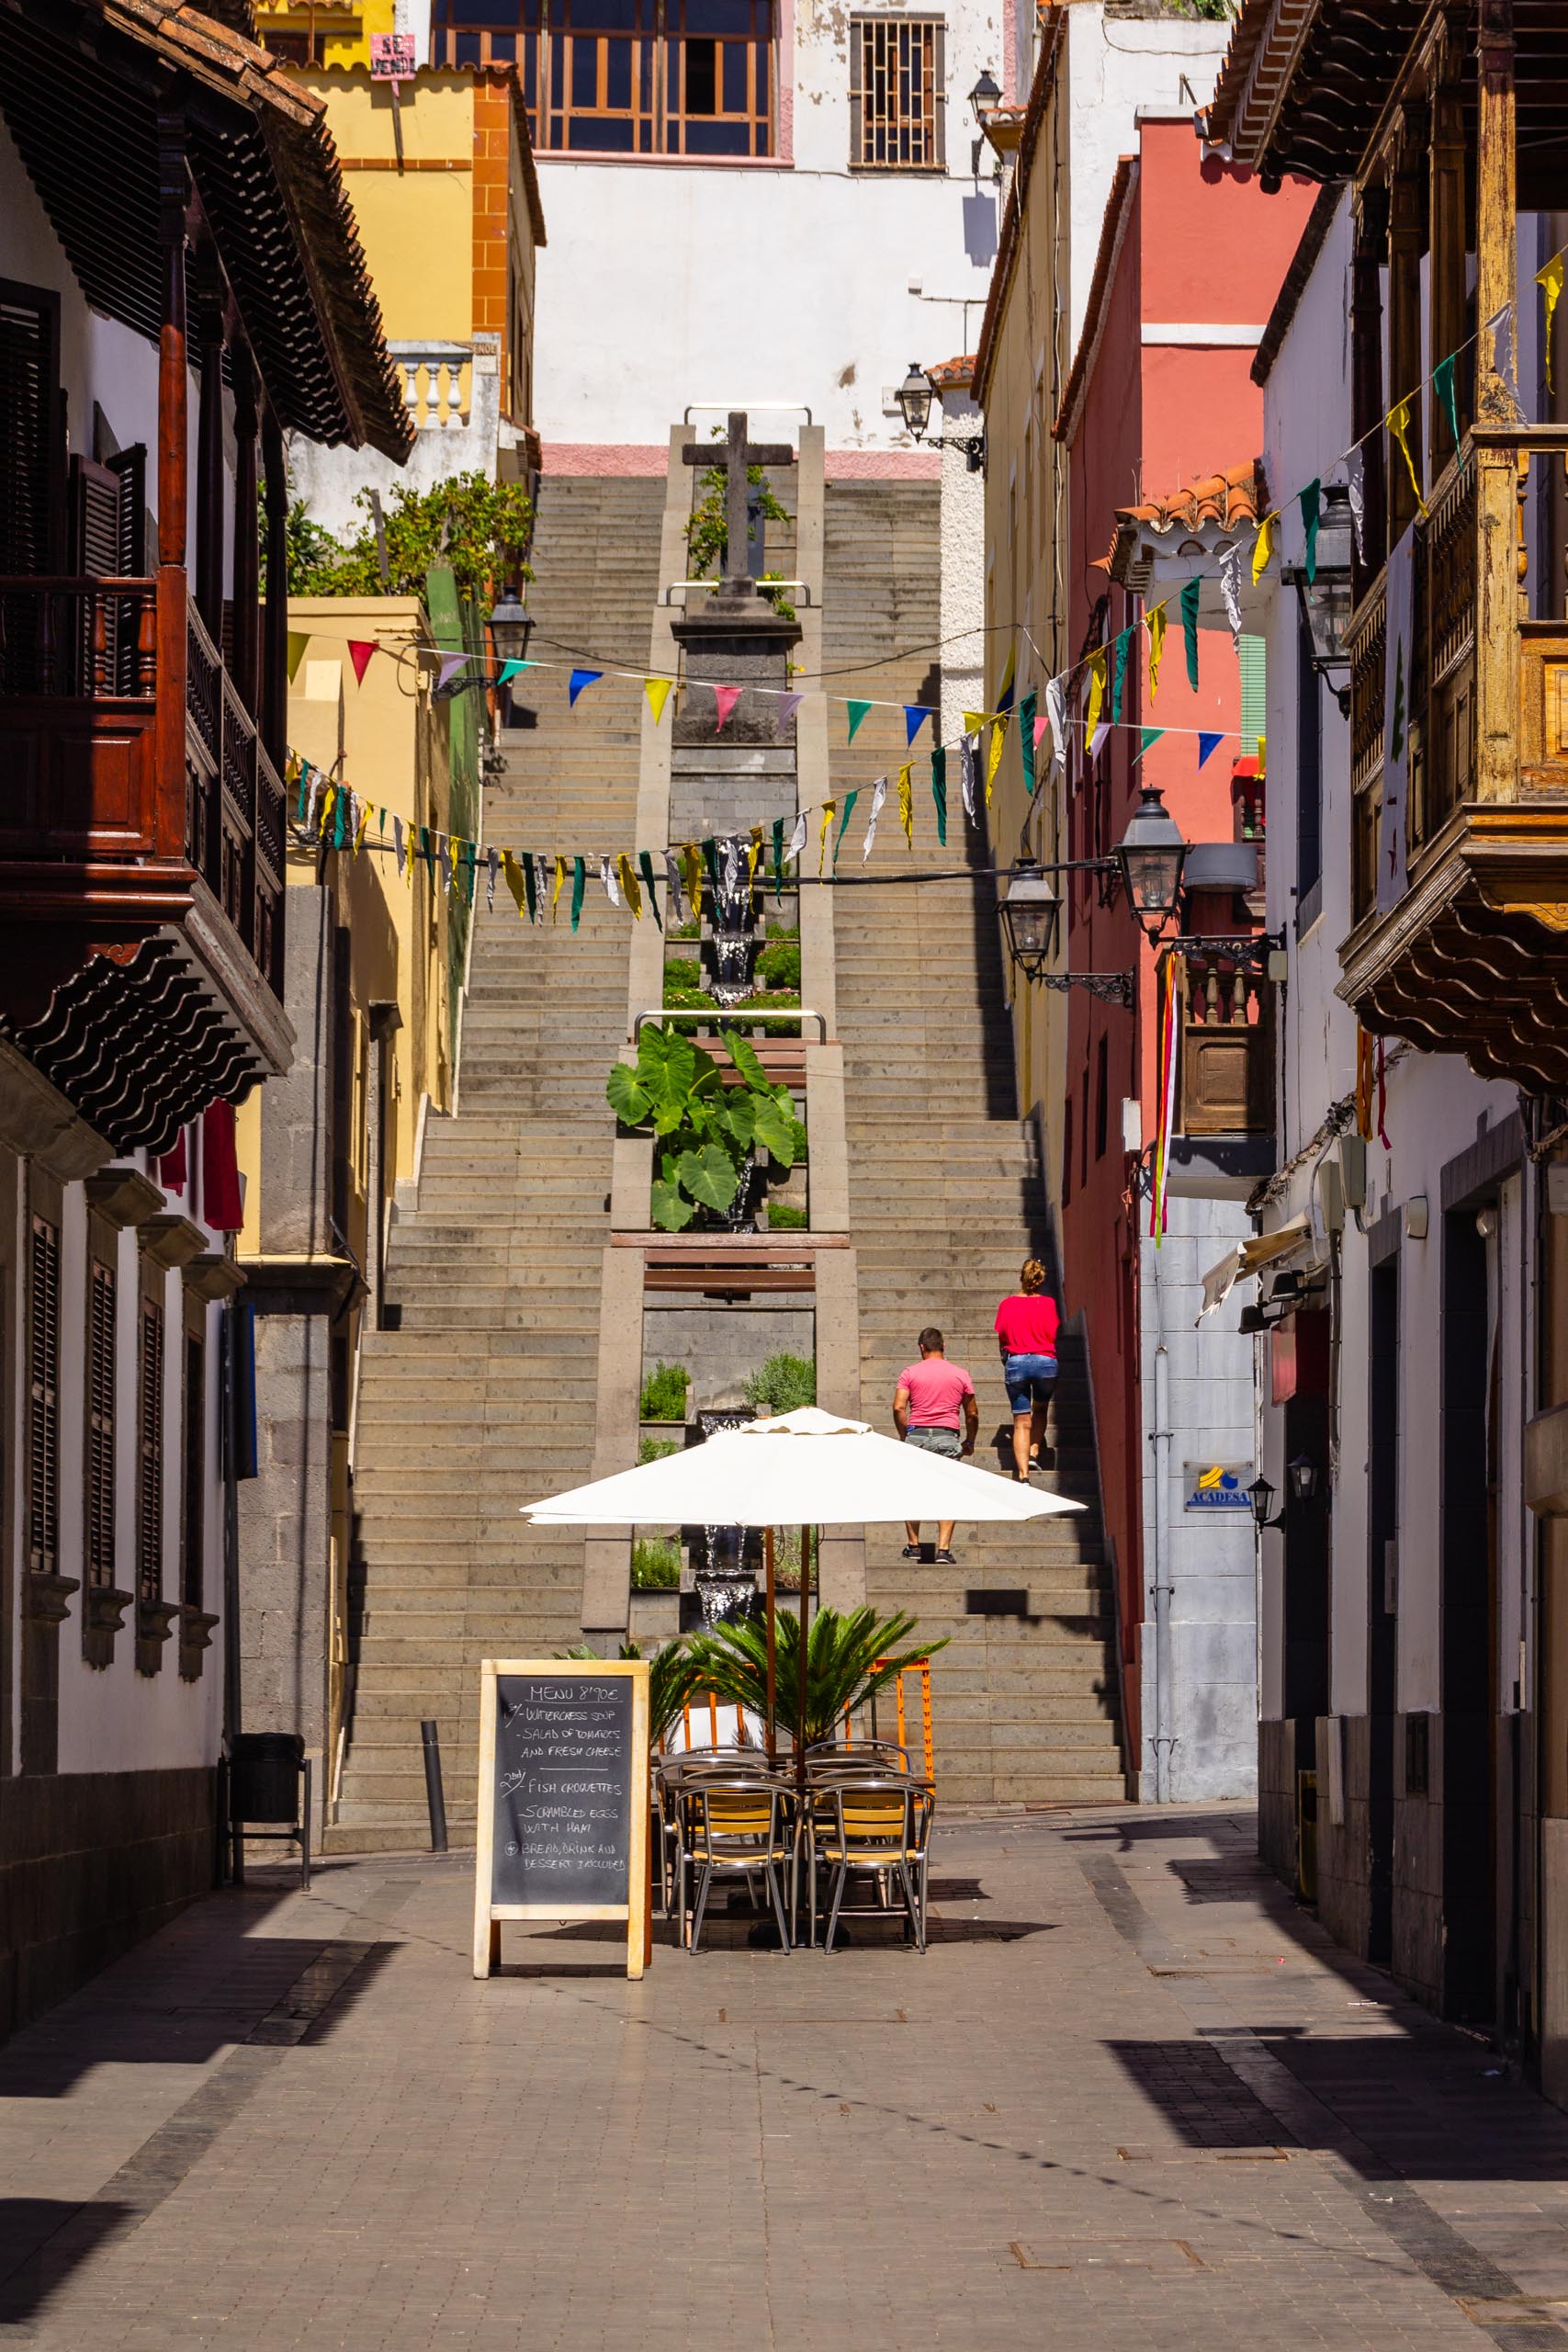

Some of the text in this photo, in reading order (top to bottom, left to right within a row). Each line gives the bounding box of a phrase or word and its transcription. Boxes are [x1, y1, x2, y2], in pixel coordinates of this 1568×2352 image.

[382, 35, 404, 54] SE
[471, 343, 497, 355] ENDE
[1190, 1491, 1248, 1502] ACADESA
[530, 1686, 573, 1702] MENU
[591, 1710, 615, 1722] SOUP
[521, 1746, 623, 1758] AND FRESH CHEESE
[560, 1782, 623, 1795] CROQUETTES
[589, 1808, 619, 1818] EGGS
[524, 1822, 591, 1834] WITH HAM
[597, 1844, 616, 1854] AND
[524, 1859, 626, 1871] DESSERT INCLUDED
